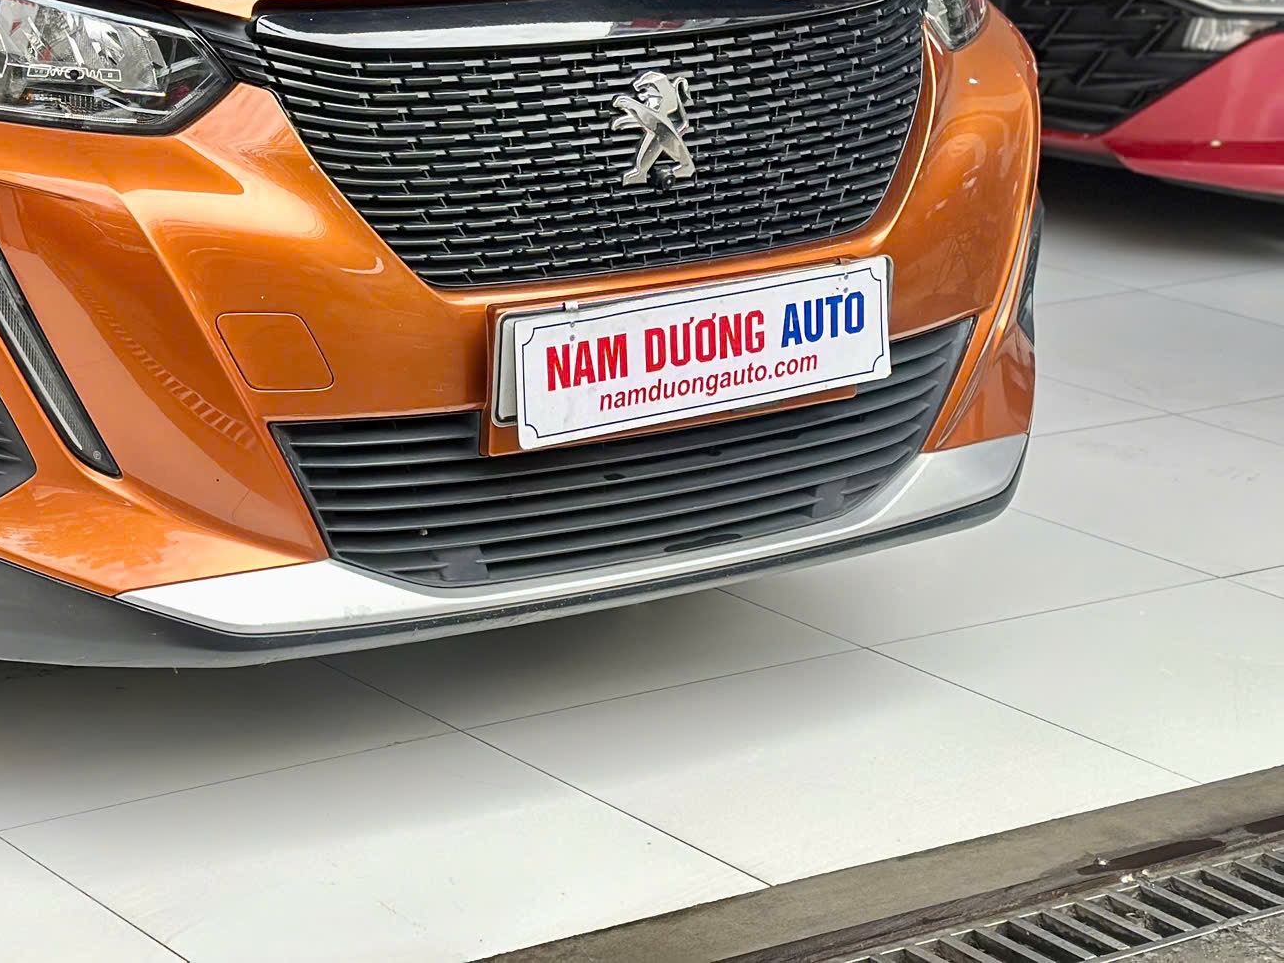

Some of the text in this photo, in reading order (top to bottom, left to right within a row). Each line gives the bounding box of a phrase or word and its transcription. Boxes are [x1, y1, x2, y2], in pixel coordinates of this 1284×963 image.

[546, 291, 865, 391] NAM DƯƠNG AUTO
[600, 354, 818, 411] namduongauto.com
